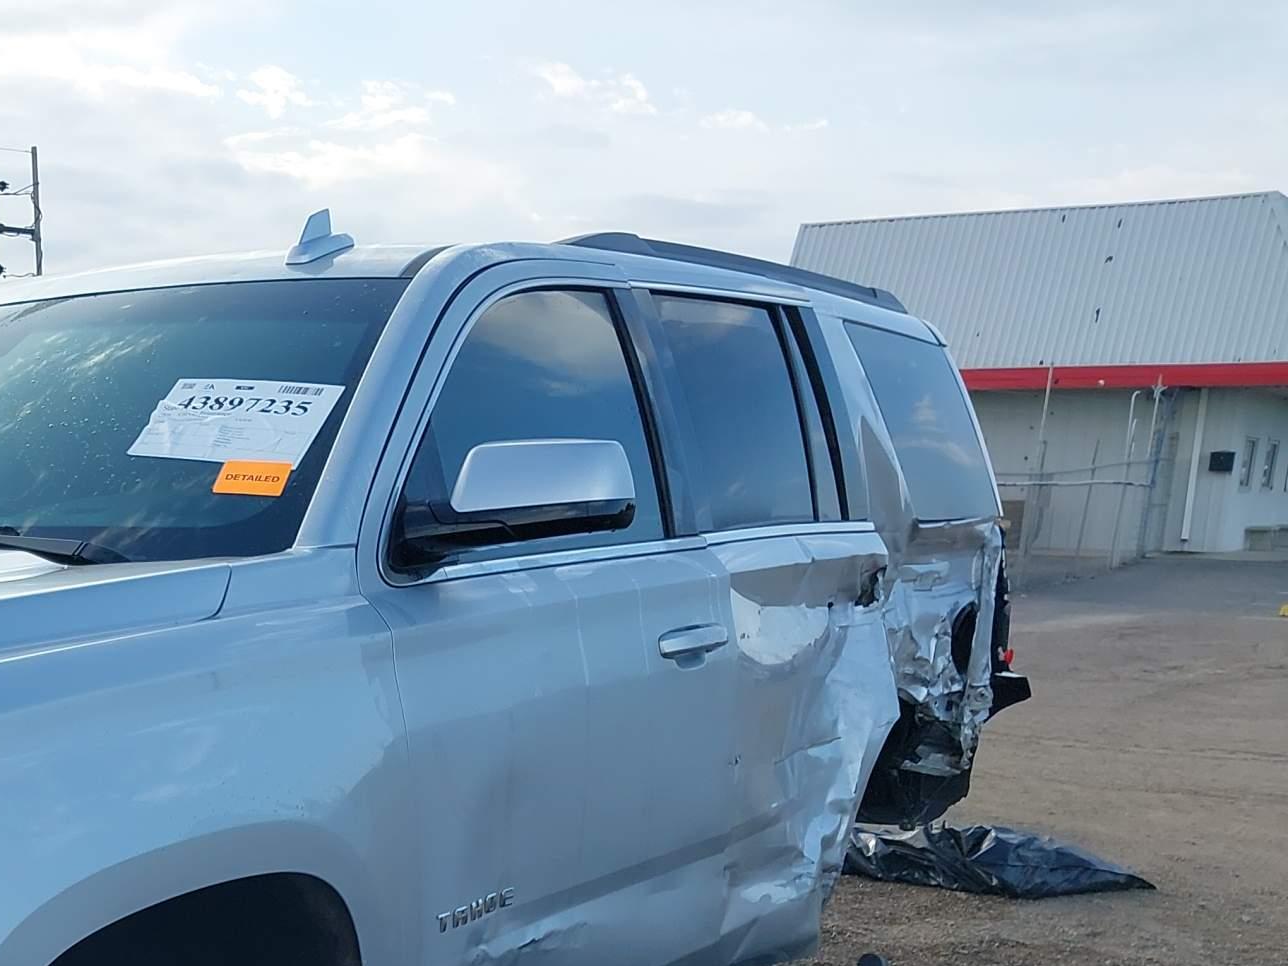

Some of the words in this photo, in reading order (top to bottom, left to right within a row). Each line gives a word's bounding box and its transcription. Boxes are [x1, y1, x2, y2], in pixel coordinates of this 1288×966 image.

[177, 394, 313, 417] 43897235
[224, 472, 281, 484] DETAILED
[436, 887, 515, 934] TAHOE
